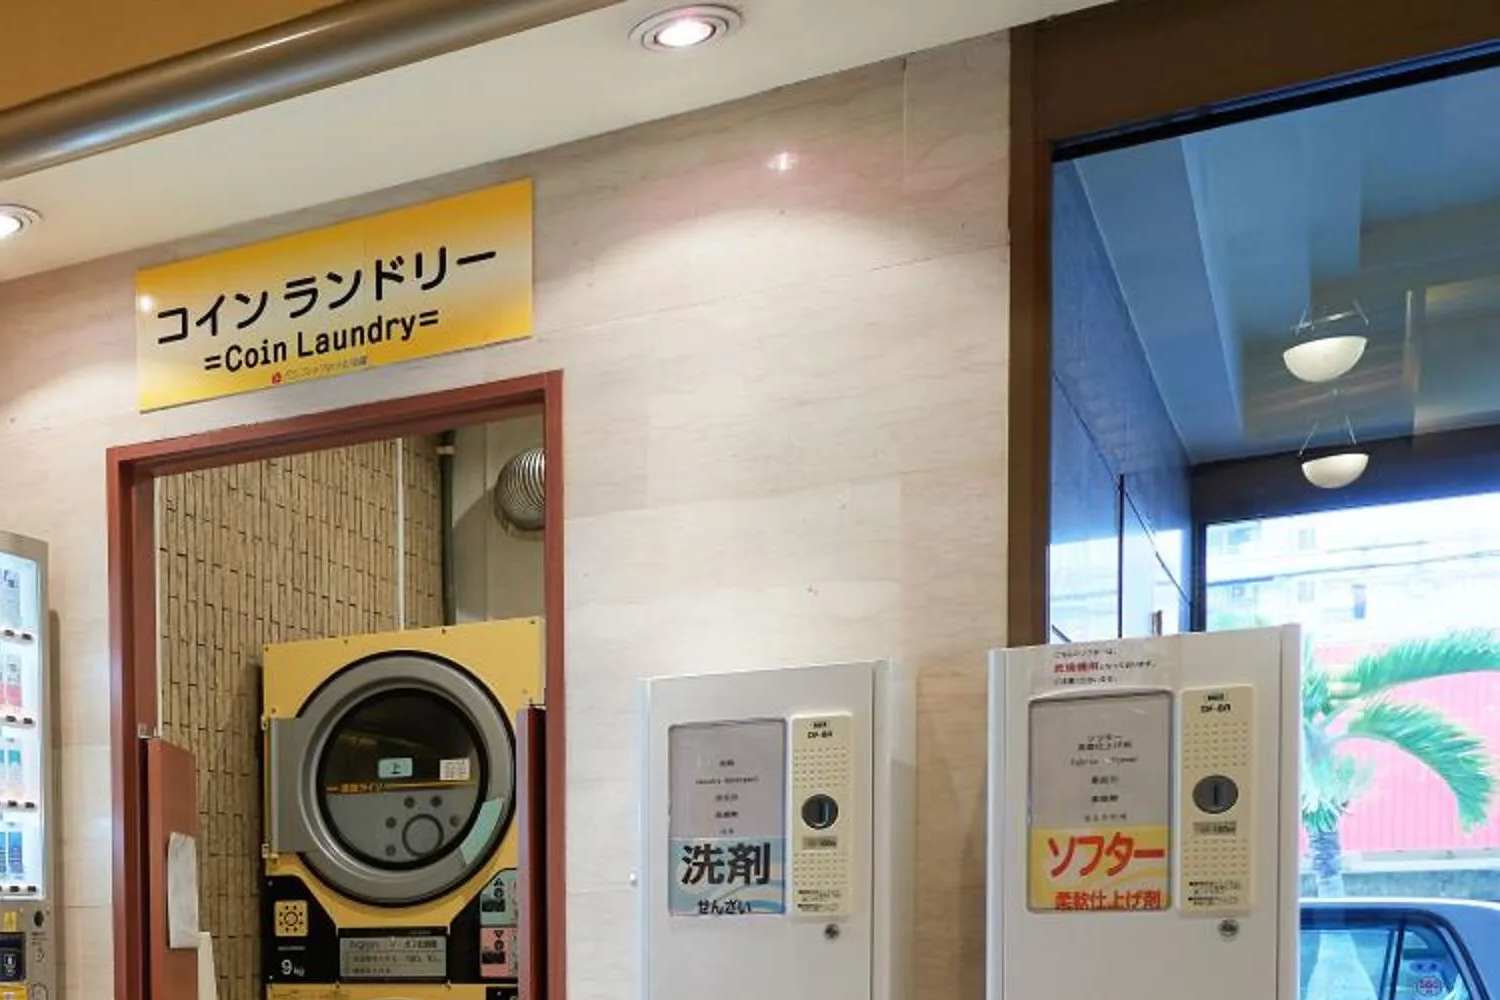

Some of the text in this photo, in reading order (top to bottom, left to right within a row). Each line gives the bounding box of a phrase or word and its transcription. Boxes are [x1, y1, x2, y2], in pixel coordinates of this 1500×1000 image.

[158, 246, 497, 344] コインランドリー
[681, 842, 771, 885] 洗剤
[1047, 831, 1165, 878] ソフター
[697, 898, 751, 915] せんざい
[1054, 889, 1162, 911] 柔軟仕上げ剤
